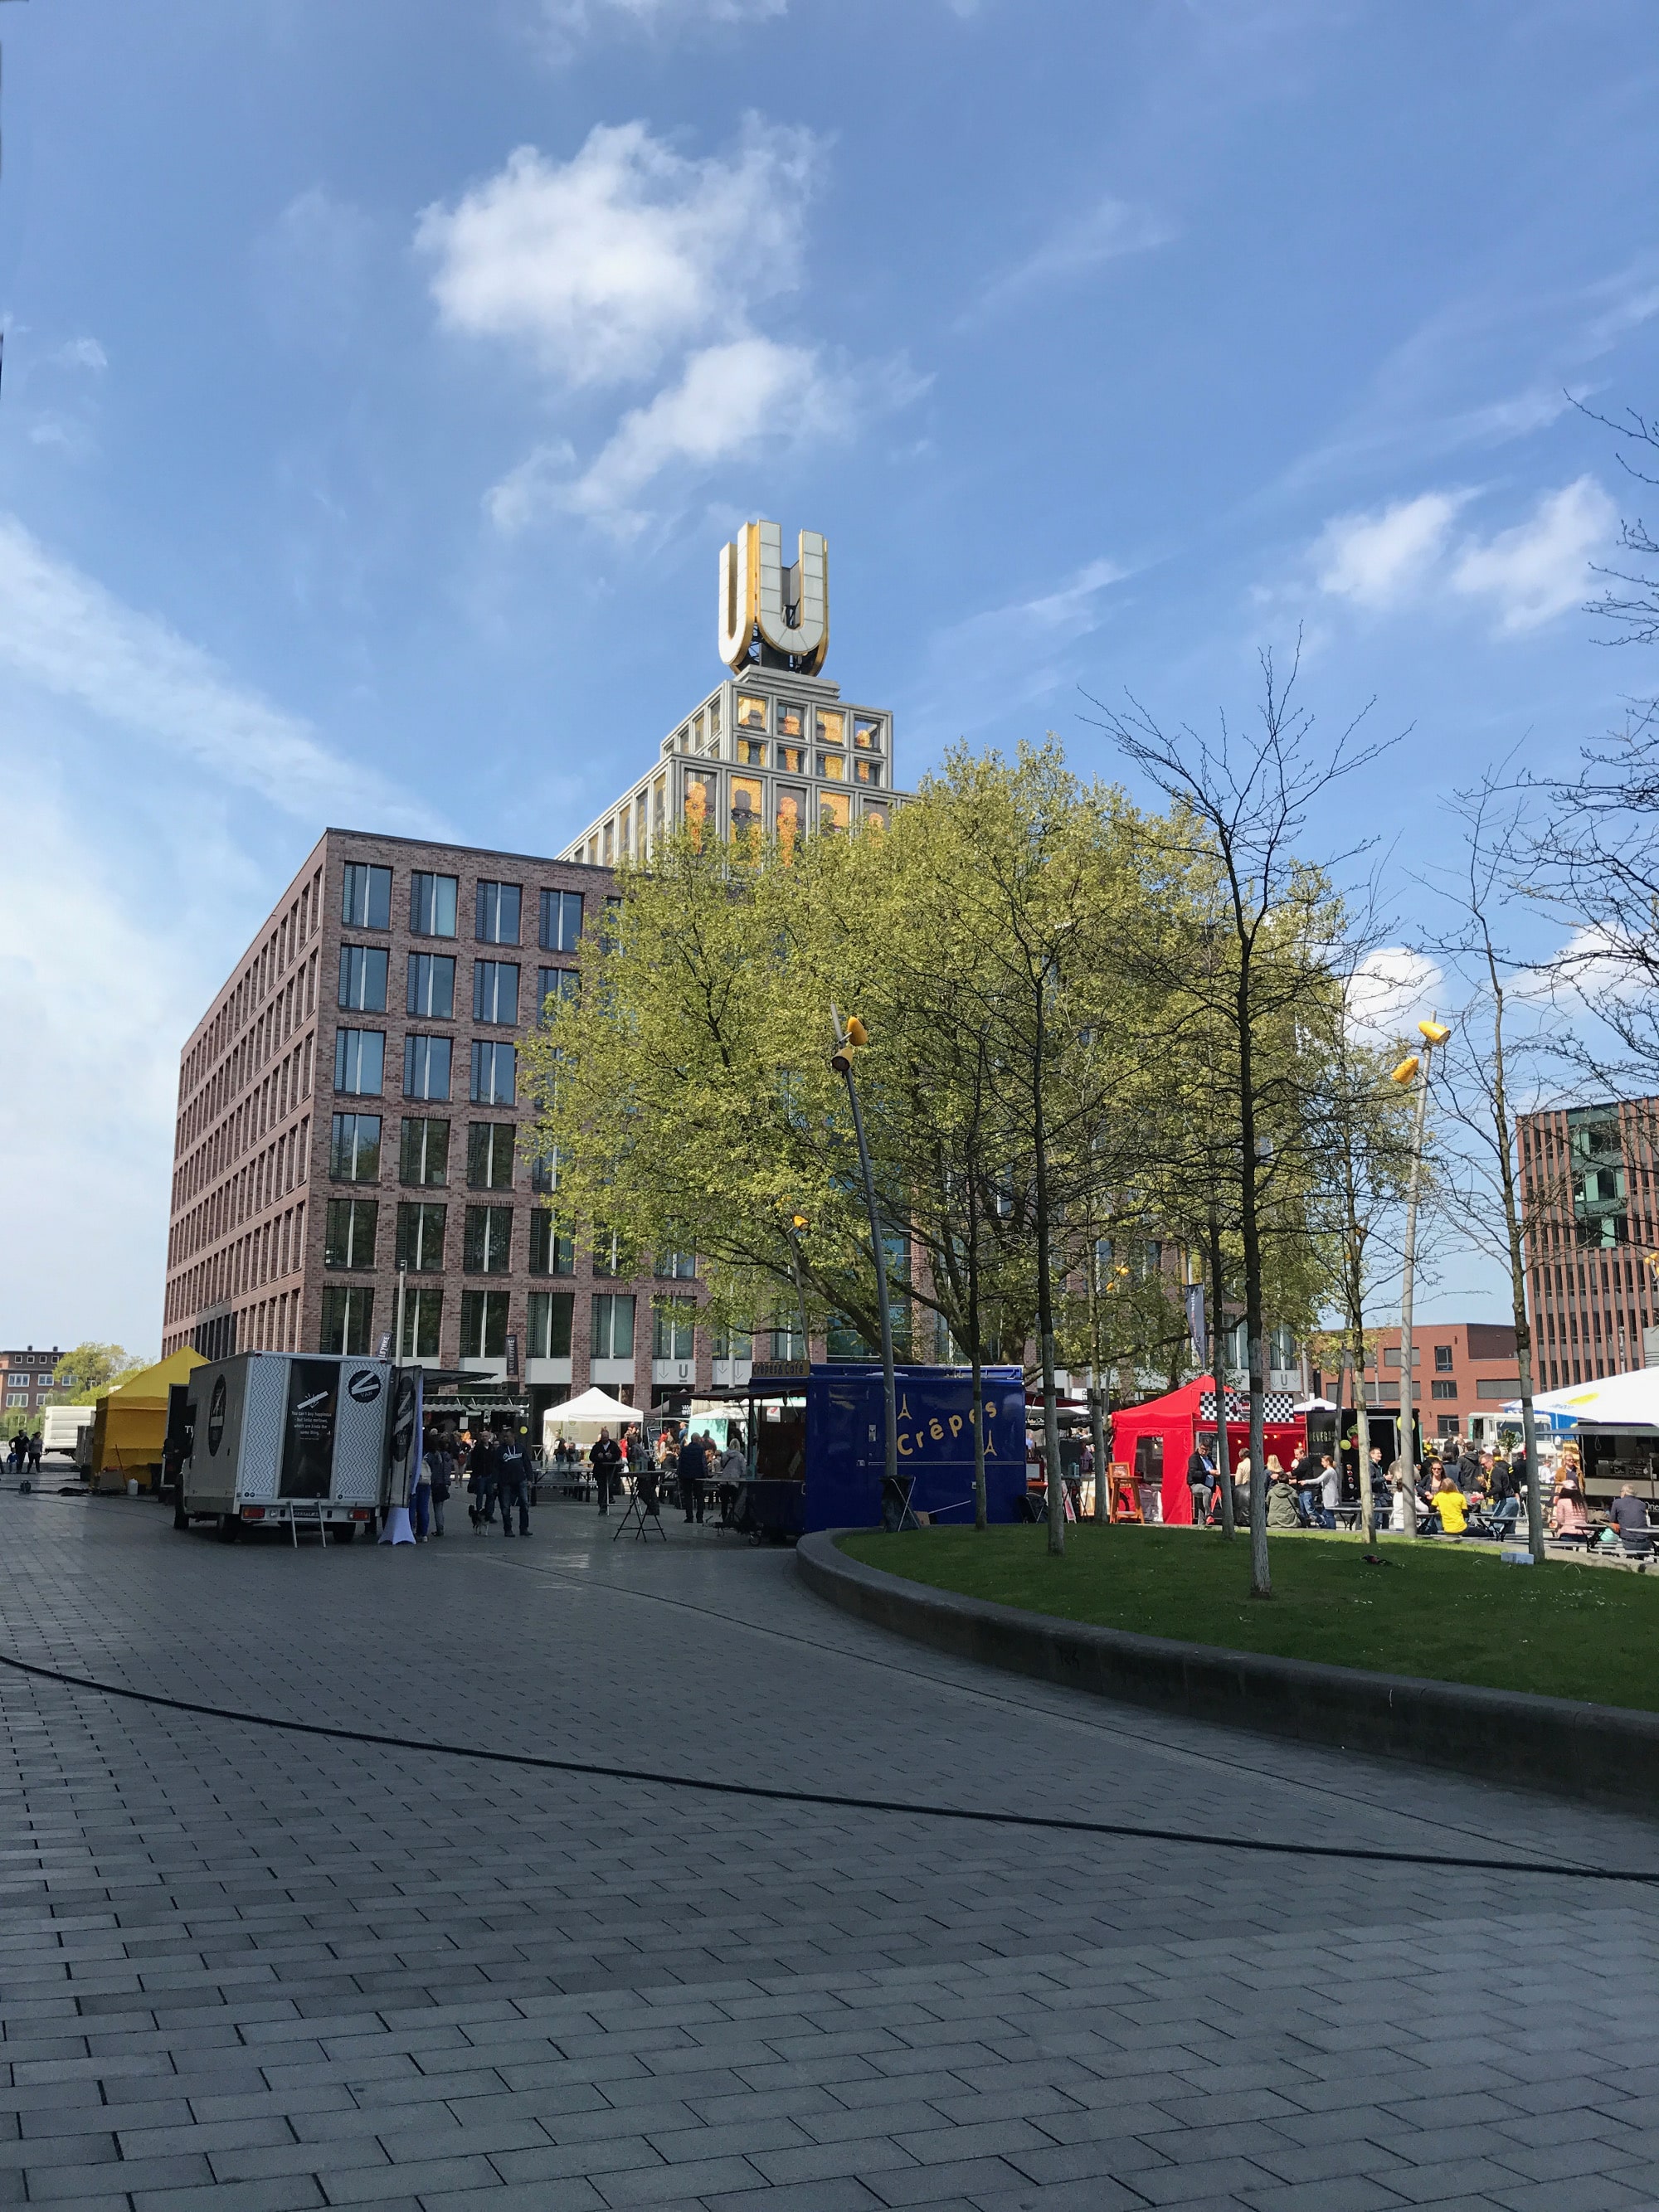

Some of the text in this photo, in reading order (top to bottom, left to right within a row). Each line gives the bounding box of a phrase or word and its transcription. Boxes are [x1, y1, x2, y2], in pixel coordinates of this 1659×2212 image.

[679, 1364, 688, 1378] U
[1280, 1373, 1288, 1386] U
[897, 1401, 997, 1456] Crêpes
